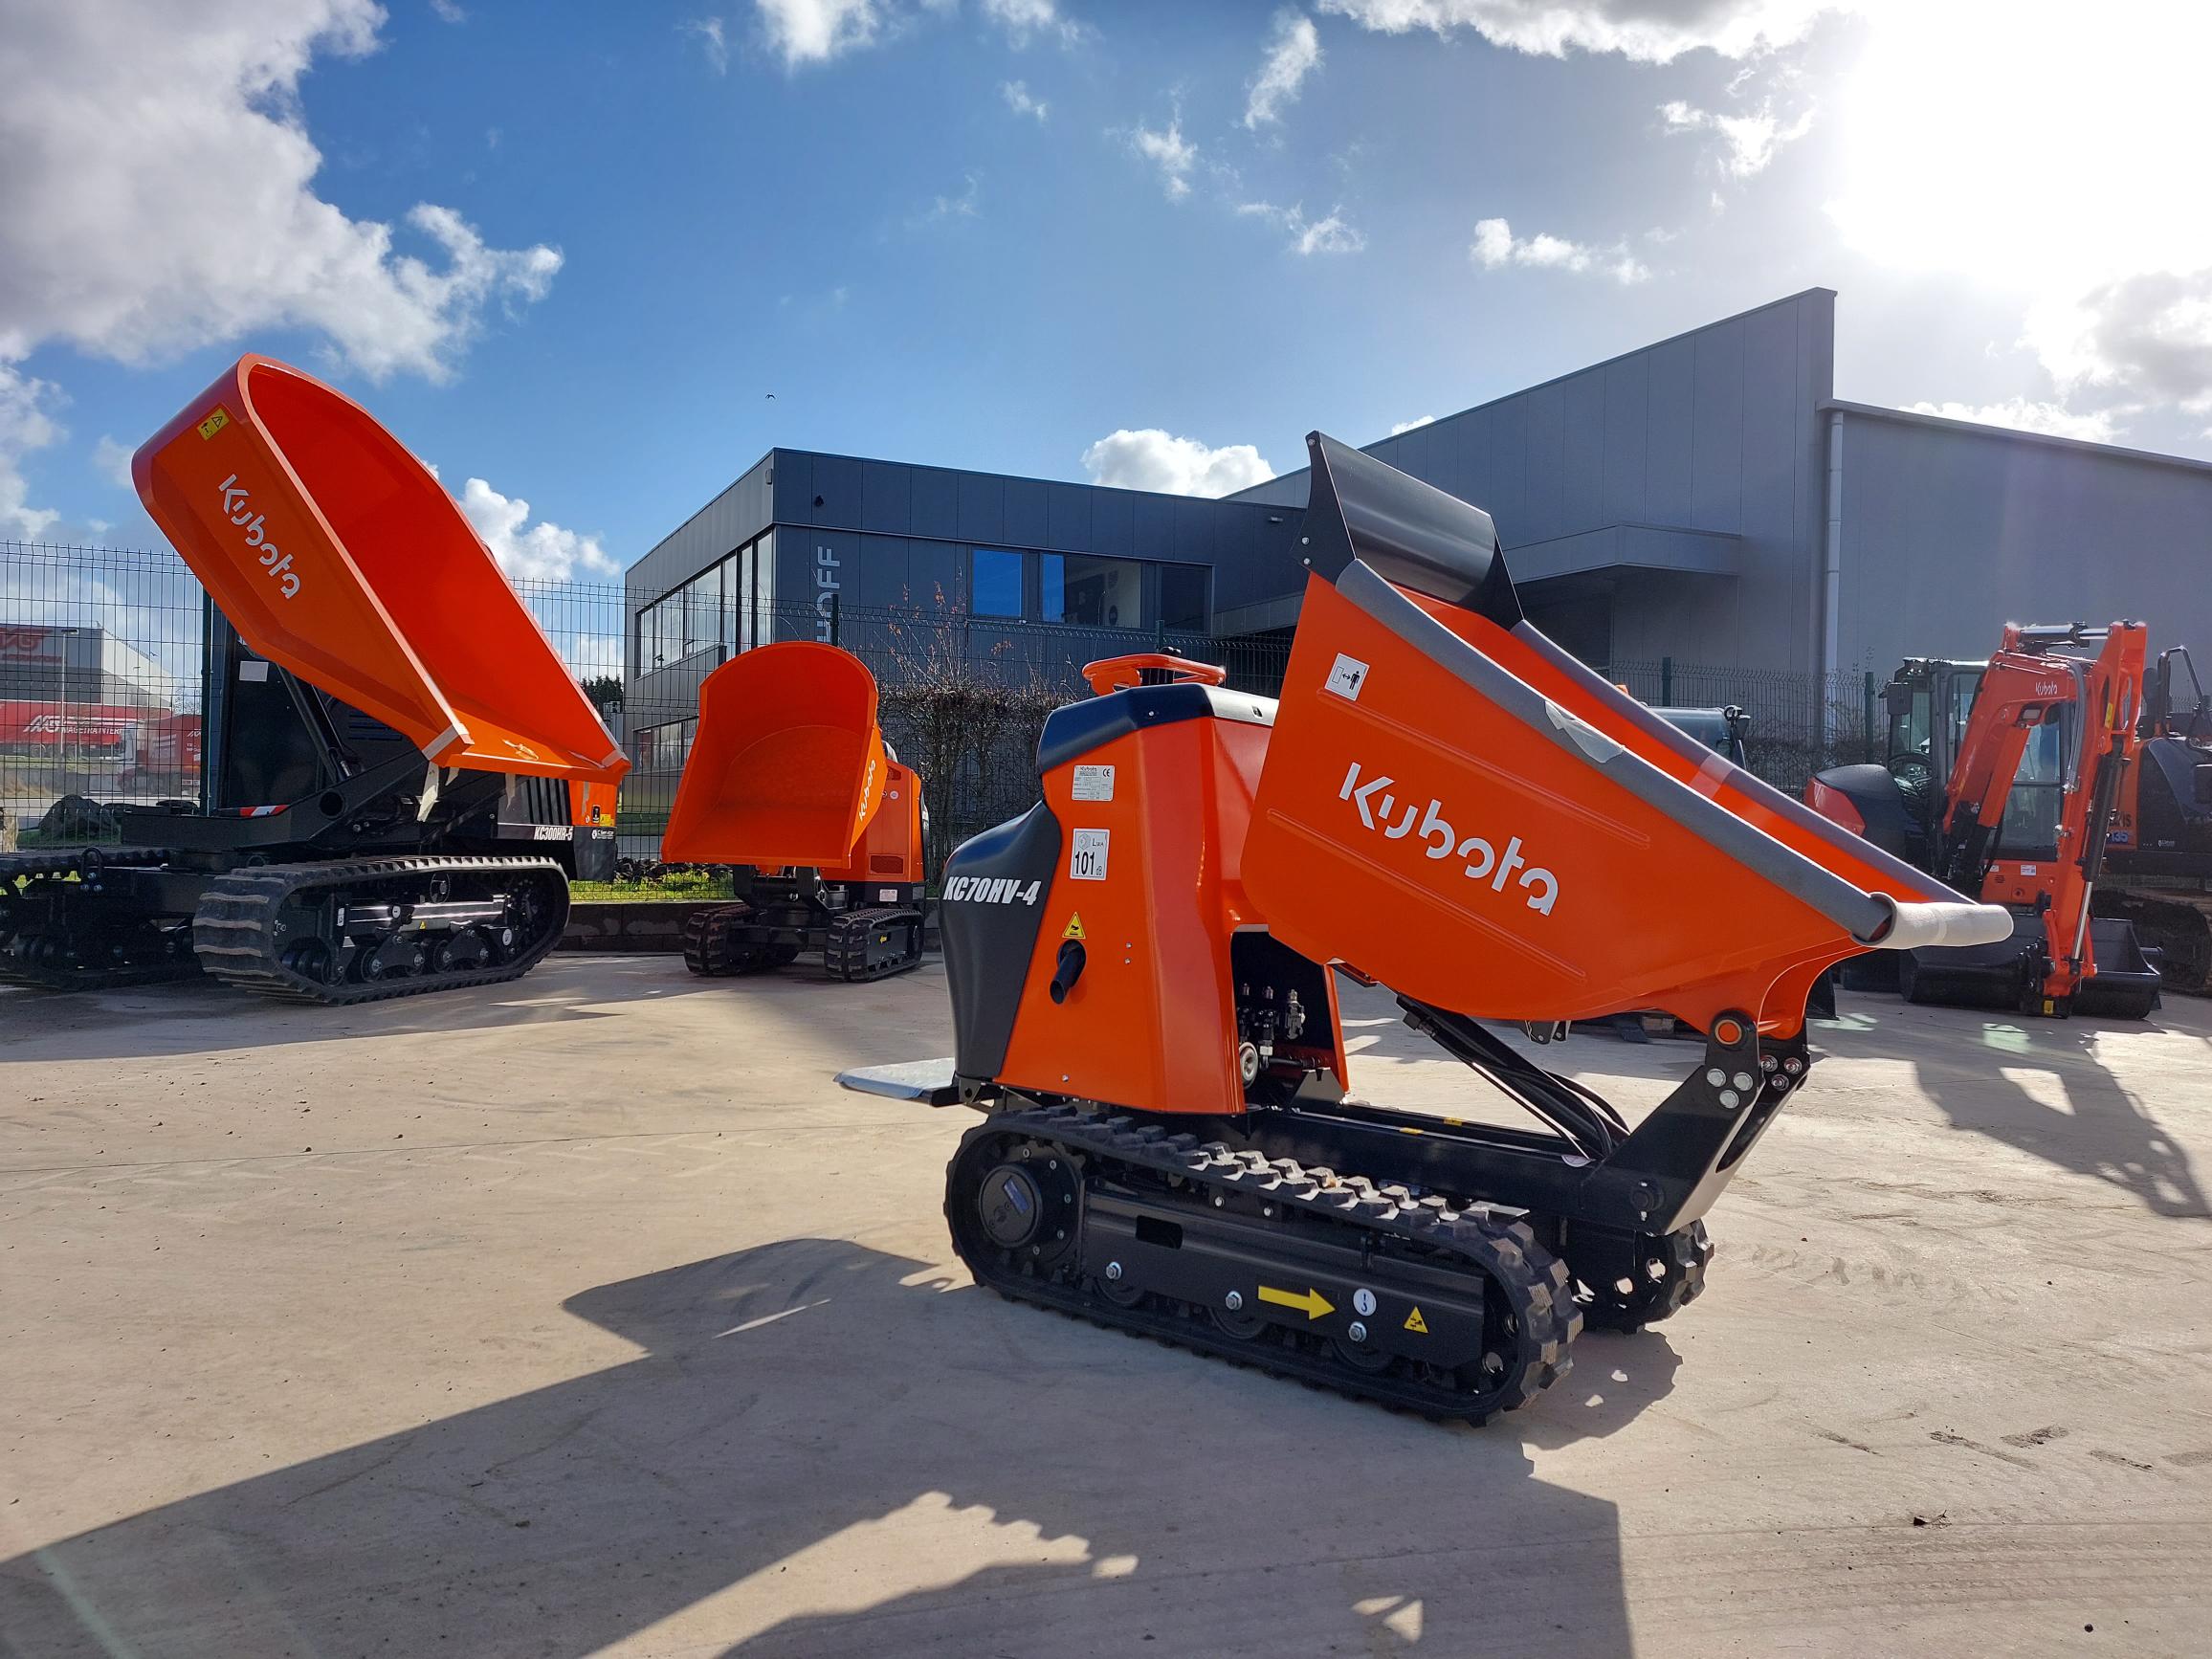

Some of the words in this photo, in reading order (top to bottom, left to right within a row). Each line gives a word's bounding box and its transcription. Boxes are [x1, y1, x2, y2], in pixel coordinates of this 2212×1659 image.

[218, 474, 300, 599] Kubota
[2035, 680, 2058, 696] Kubota
[858, 759, 876, 821] Kubota
[533, 826, 574, 841] KC300HR-5
[1338, 762, 1559, 917] Kubota
[1074, 851, 1095, 875] 101
[942, 876, 1042, 906] KC70HV-4
